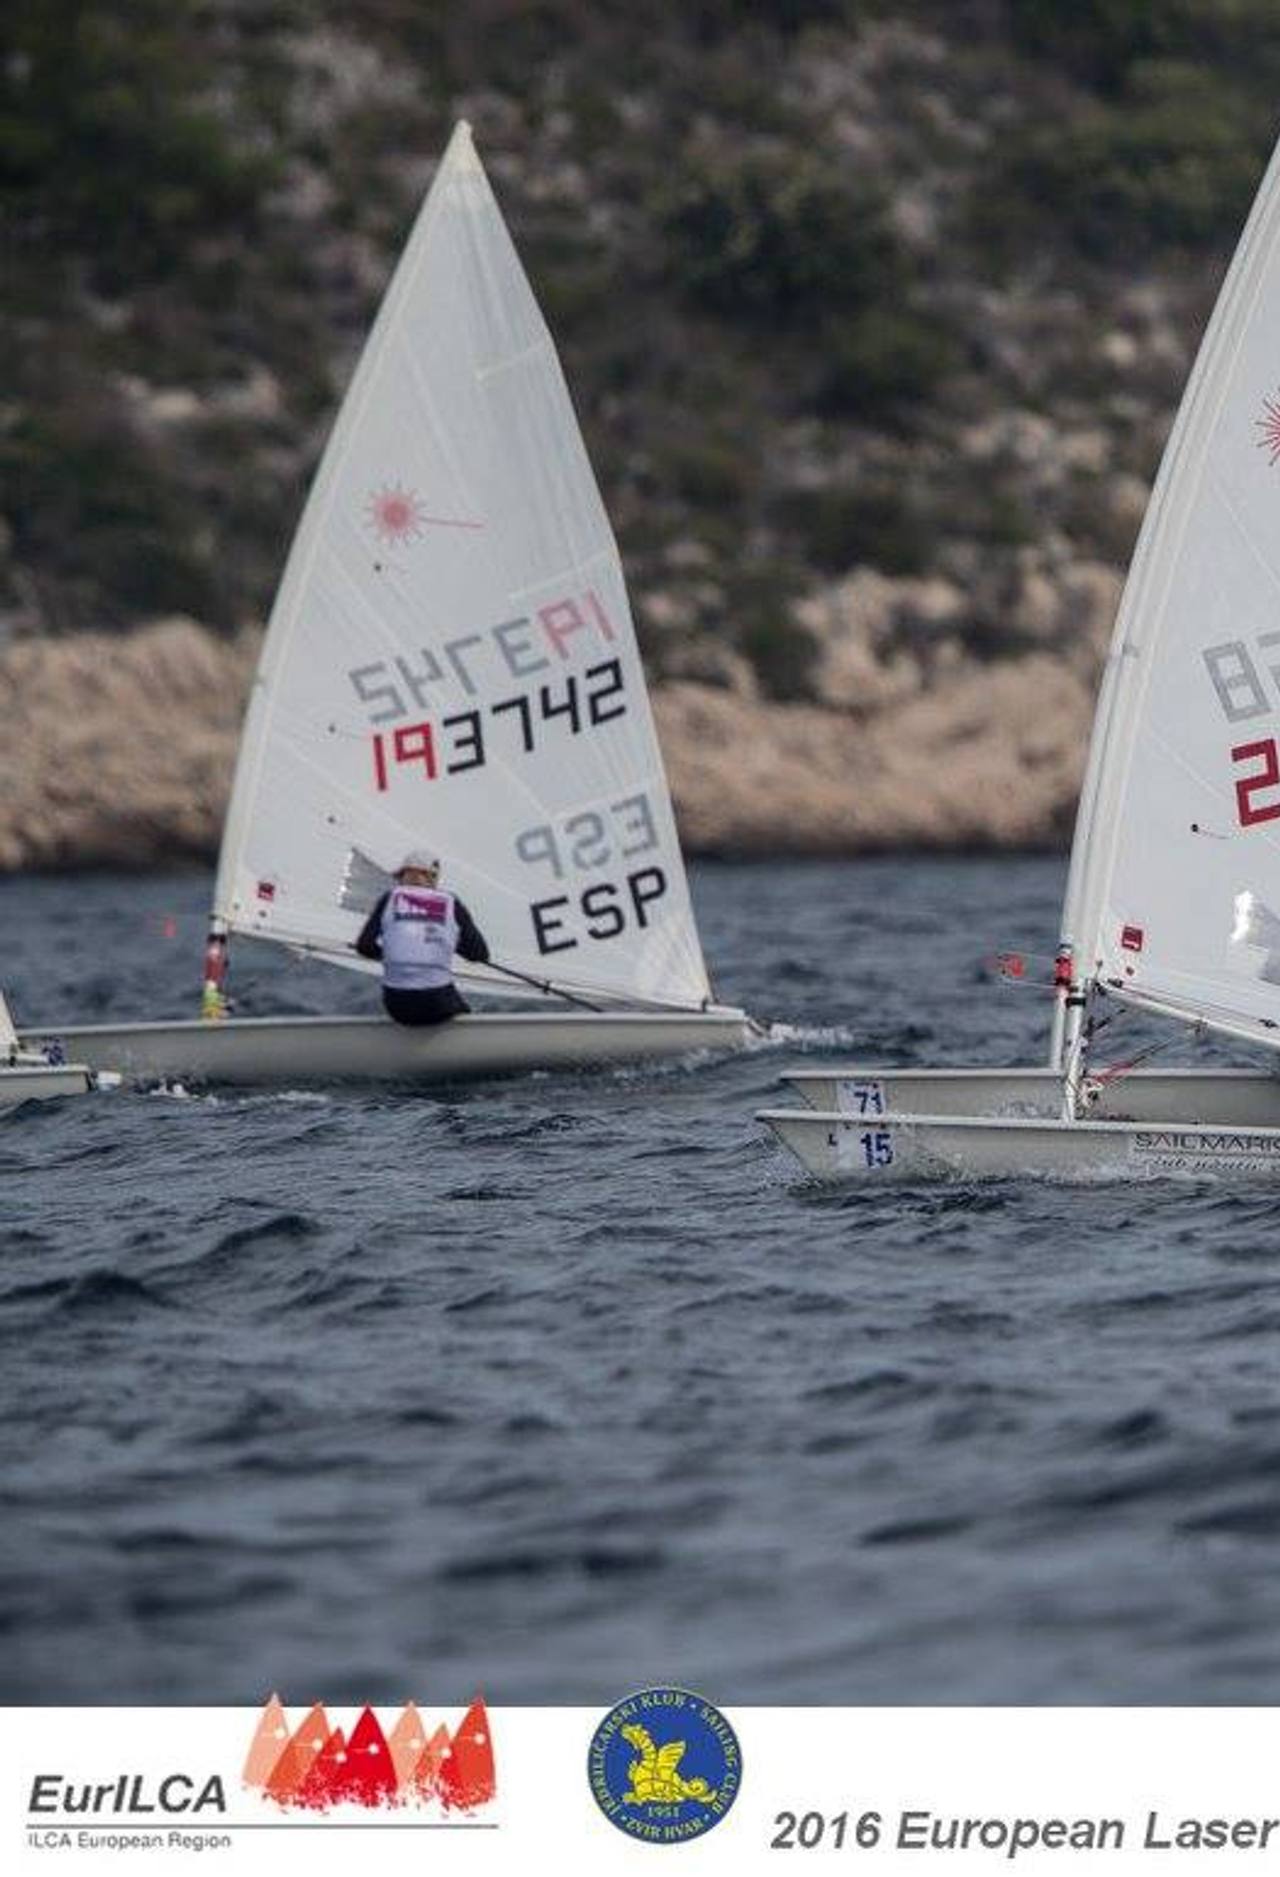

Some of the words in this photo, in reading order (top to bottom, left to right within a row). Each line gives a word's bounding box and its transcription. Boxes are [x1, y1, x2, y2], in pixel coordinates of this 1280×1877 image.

[372, 659, 627, 792] 193742
[531, 866, 668, 956] ESP
[854, 1090, 883, 1115] 71
[860, 1132, 894, 1168] 15
